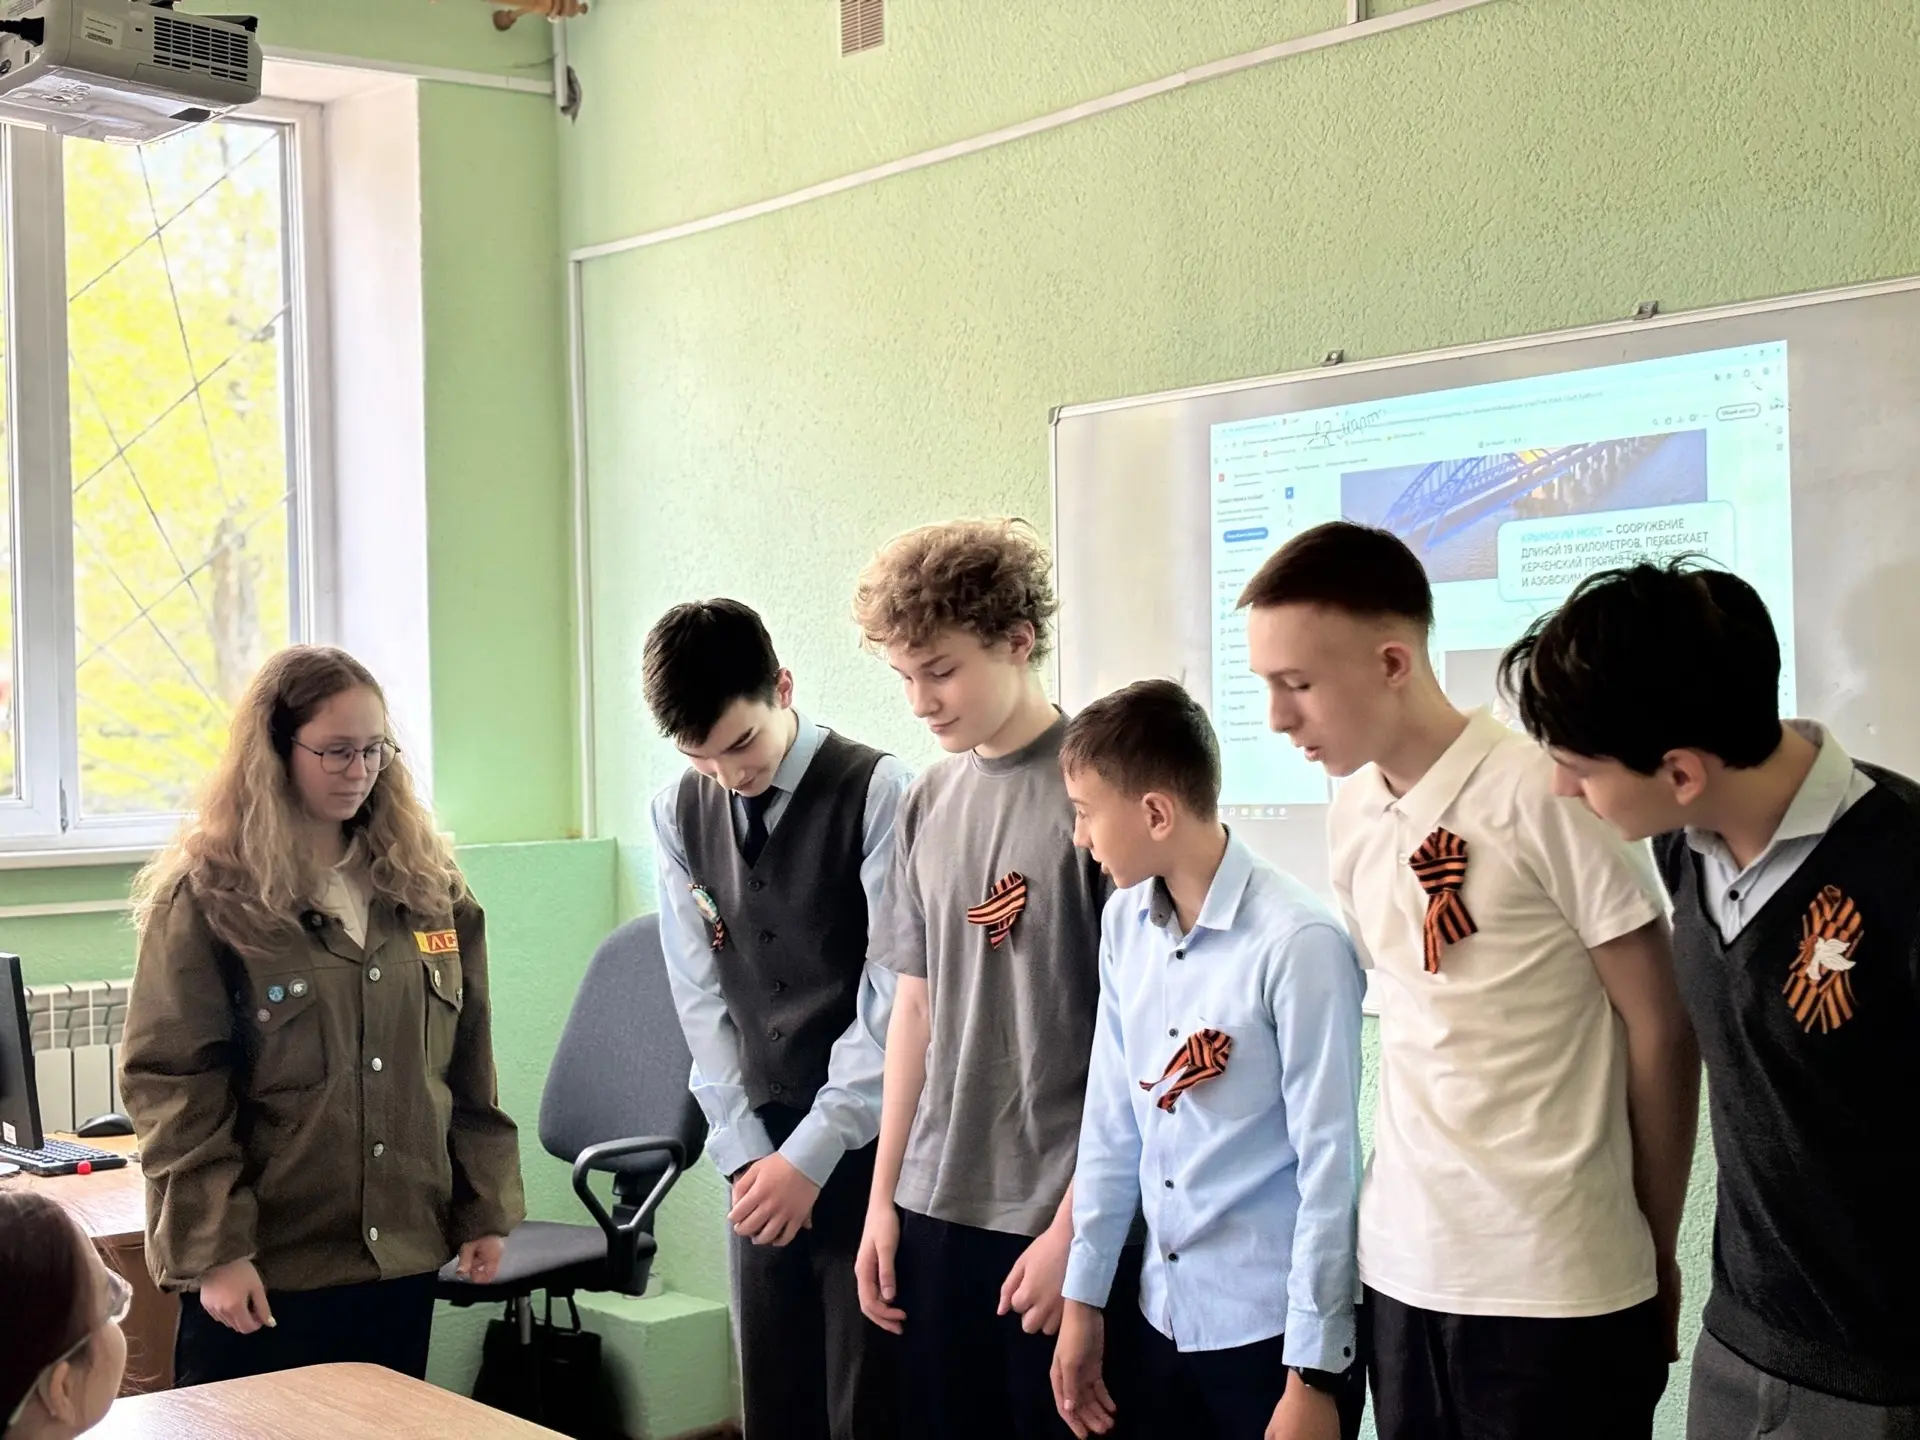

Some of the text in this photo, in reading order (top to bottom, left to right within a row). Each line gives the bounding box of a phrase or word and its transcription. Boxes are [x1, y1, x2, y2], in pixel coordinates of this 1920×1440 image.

[1577, 526, 1604, 537] МОСТ
[1615, 518, 1685, 534] СООРУЖЕНИЕ
[1521, 543, 1562, 559] ДЛИНОЙ
[1563, 545, 1573, 555] 19
[1645, 532, 1709, 548] ПЕРЕСЕКАЕТ
[1521, 556, 1583, 573] КЕРЧЕНСКИЙ
[1521, 578, 1529, 587] И
[1531, 573, 1581, 587] АЗОВСКИМ
